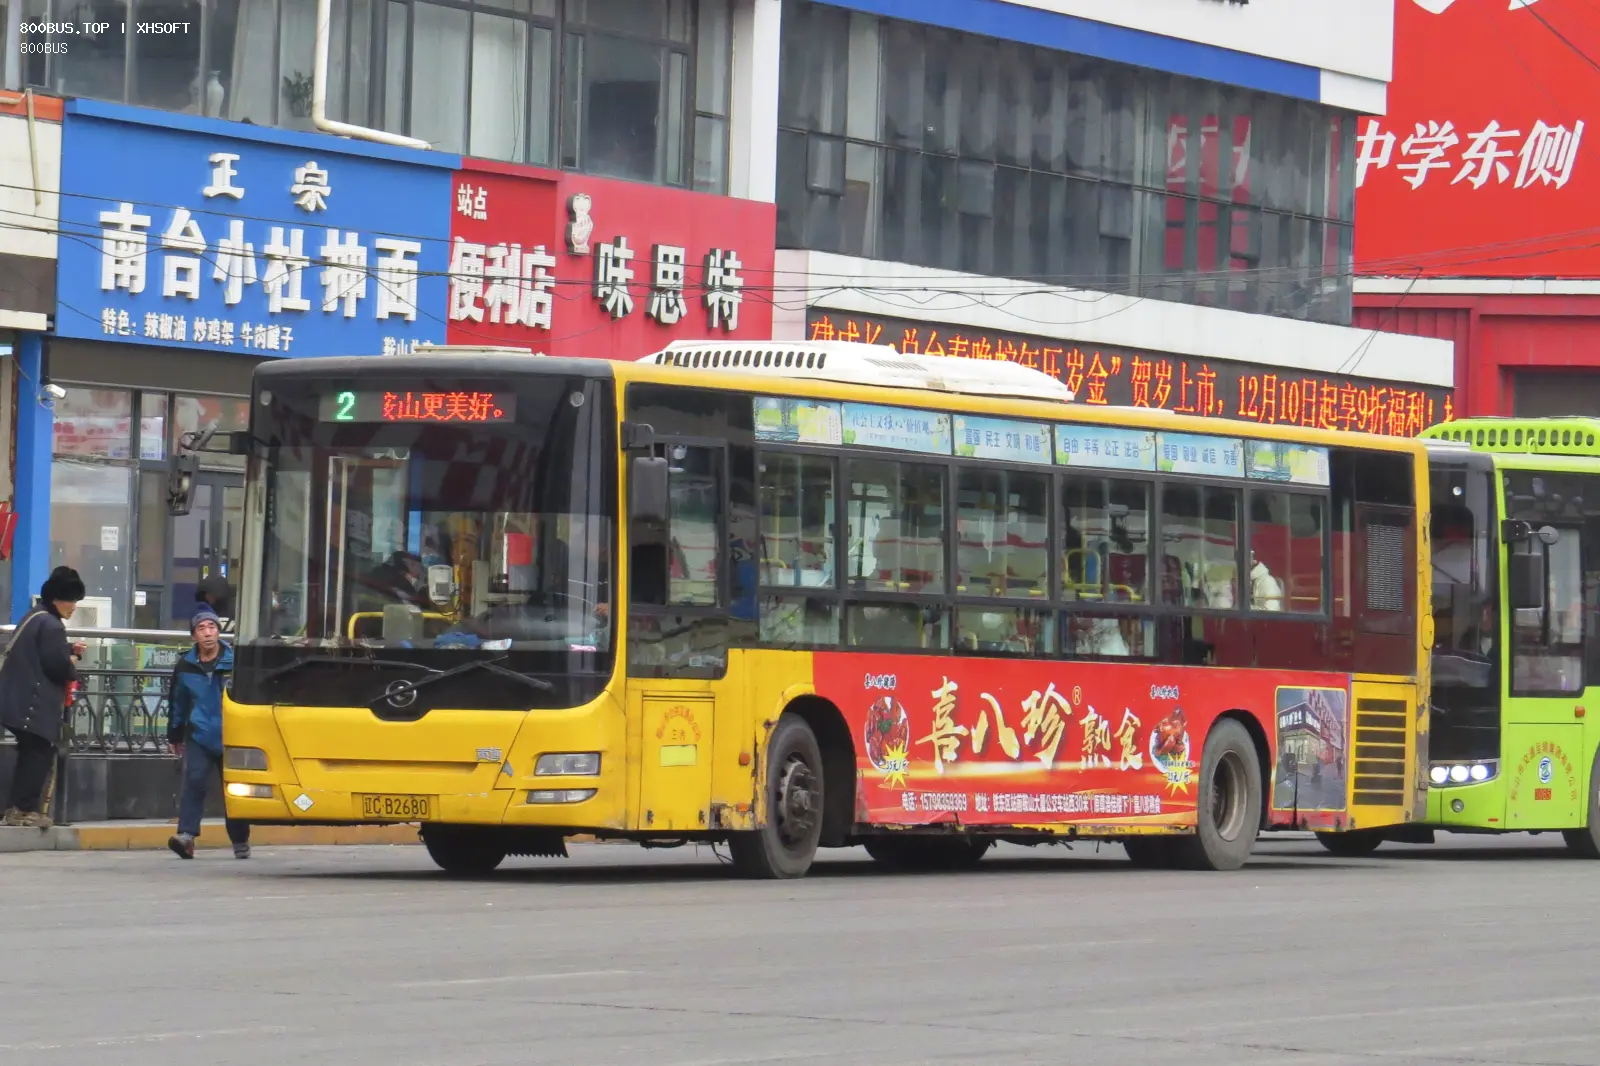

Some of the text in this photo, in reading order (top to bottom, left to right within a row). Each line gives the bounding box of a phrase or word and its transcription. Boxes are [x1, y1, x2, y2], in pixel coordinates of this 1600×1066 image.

[203, 152, 333, 213] 正宗
[456, 183, 488, 220] 站点
[448, 235, 557, 331] 便利店
[592, 235, 745, 332] 味思特
[336, 391, 356, 421] 2
[1078, 704, 1144, 772] 熟食
